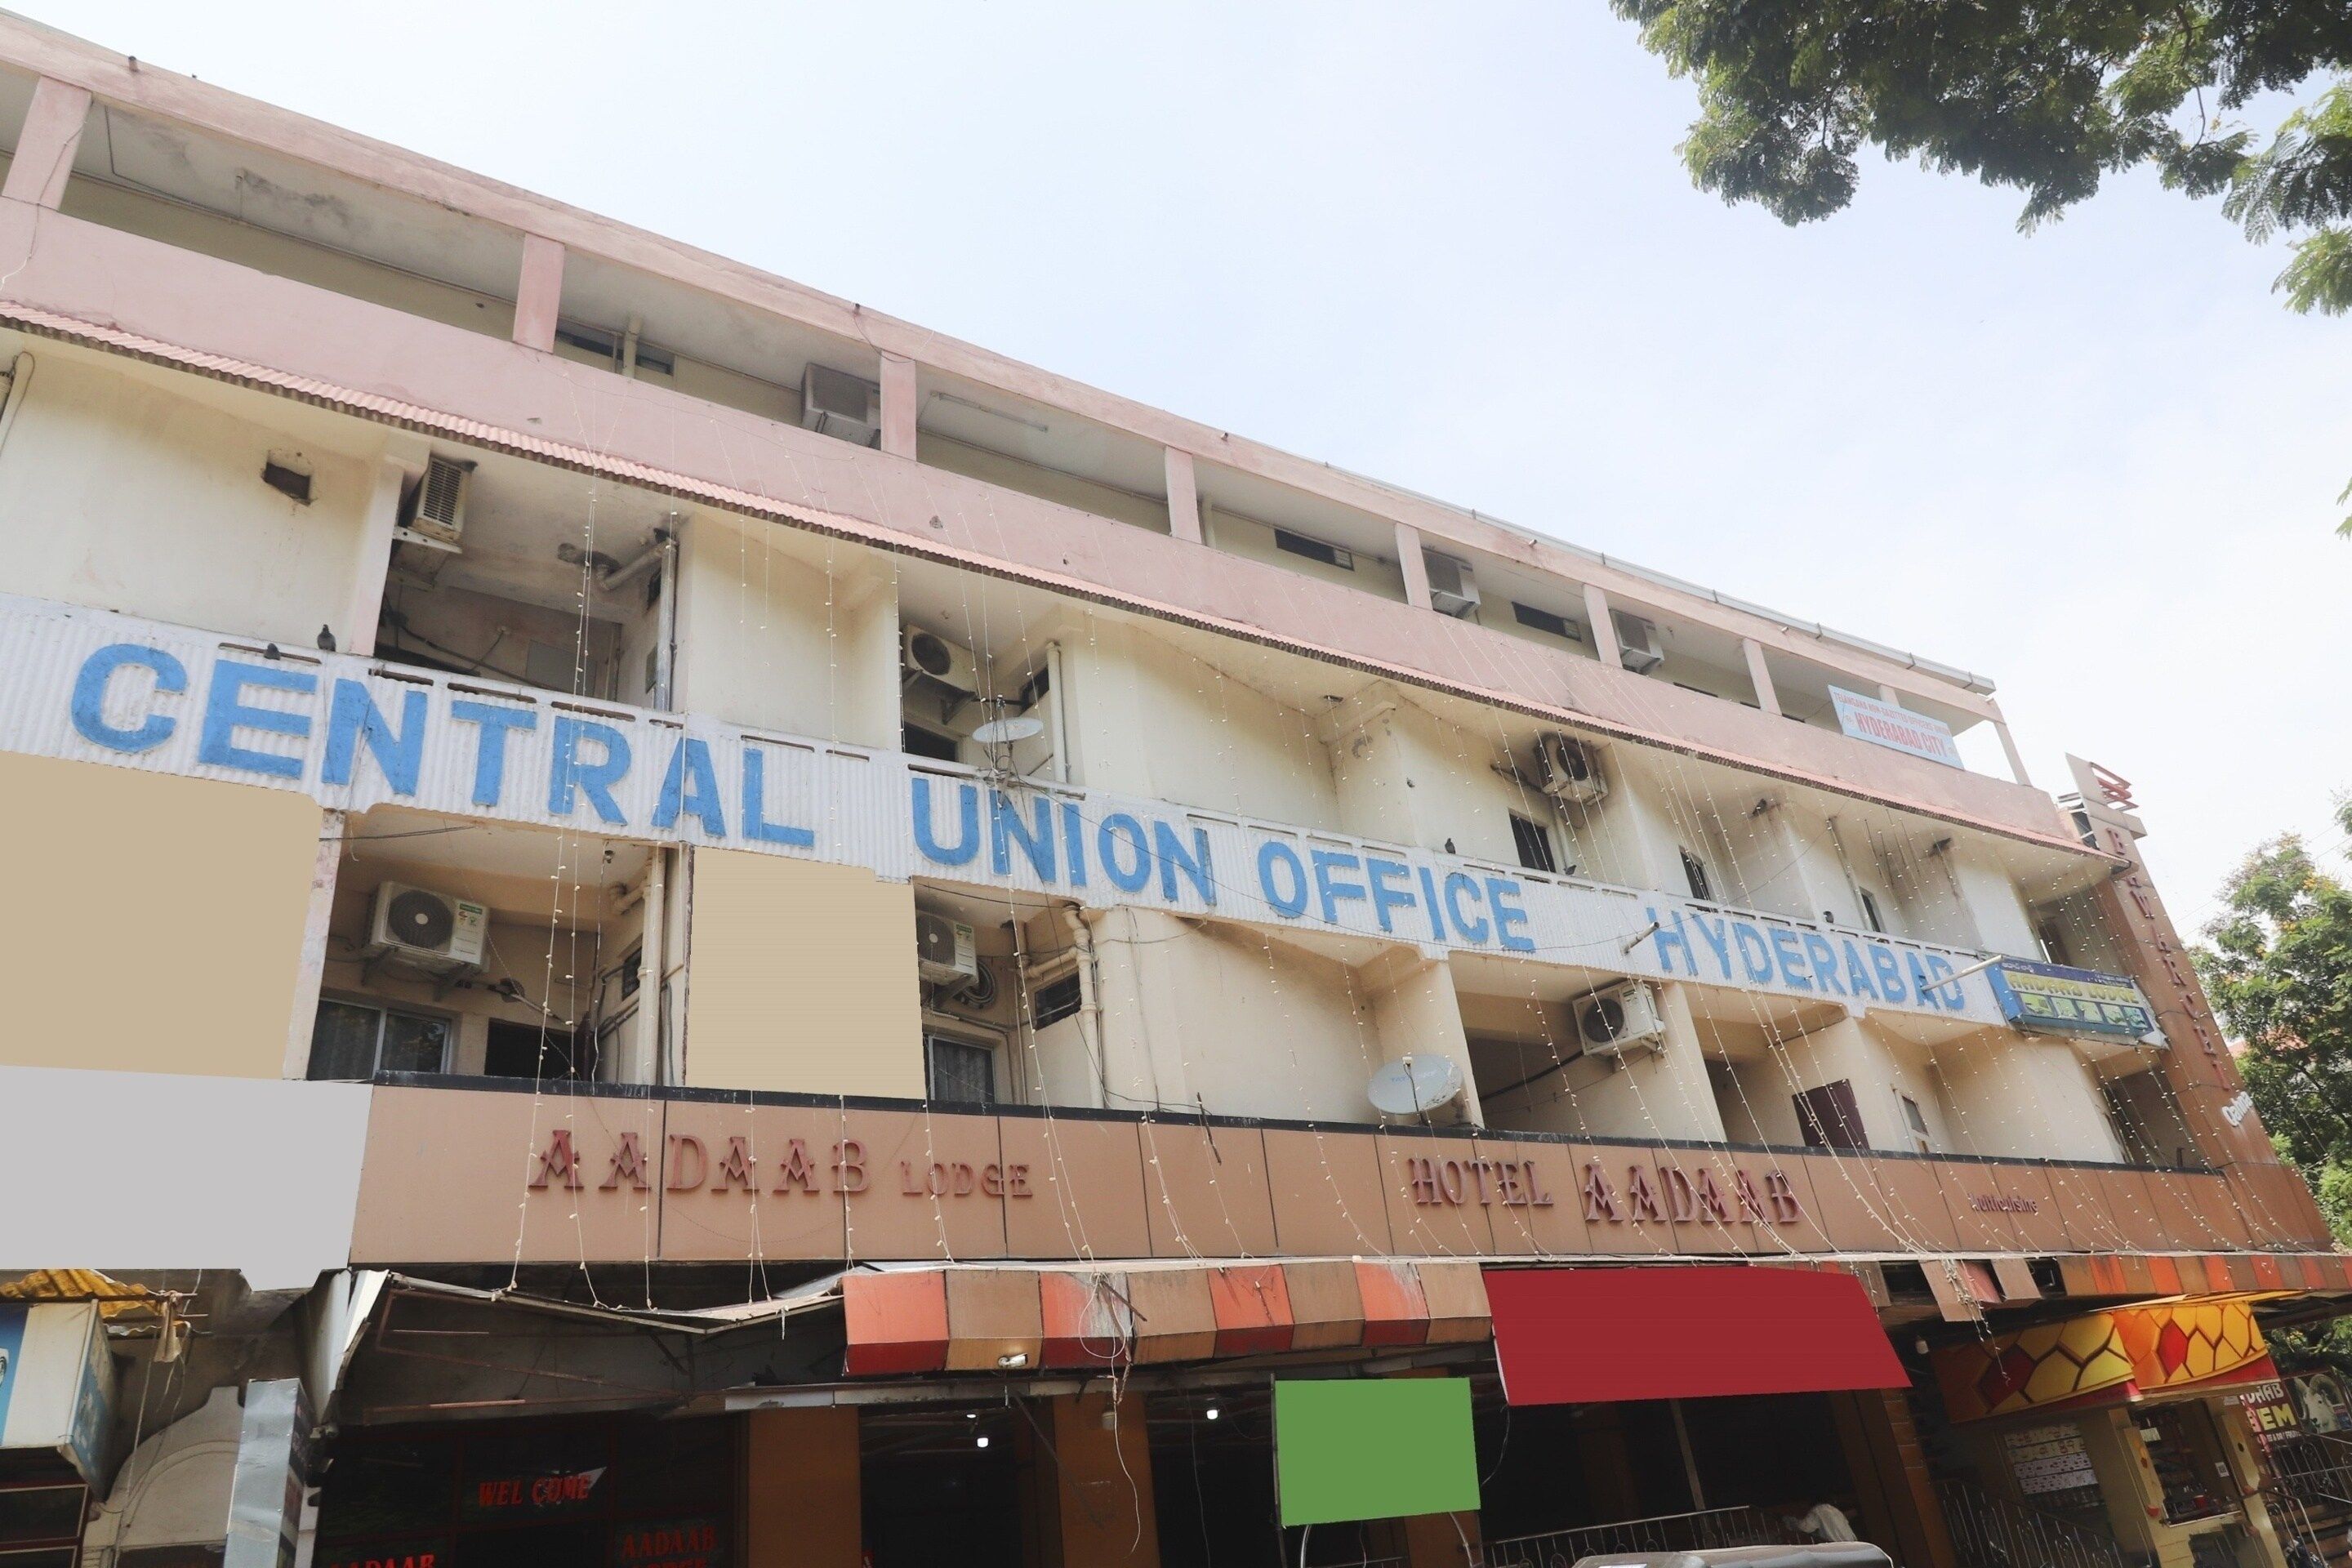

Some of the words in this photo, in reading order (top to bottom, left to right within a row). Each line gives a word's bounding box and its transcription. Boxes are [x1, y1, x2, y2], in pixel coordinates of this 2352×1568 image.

[1854, 711, 1922, 751] HYDERABAD
[1920, 731, 1949, 759] CITY
[72, 644, 814, 847] CENTRAL
[911, 777, 1217, 906] UNION
[1258, 841, 1535, 954] OFFICE
[1646, 906, 1966, 1011] HYDERABAD
[528, 1129, 871, 1194] AADAAB
[901, 1160, 1034, 1198] LODGE
[1408, 1157, 1555, 1205] HOTEL
[1584, 1163, 1801, 1224] AADAAB
[479, 1481, 523, 1507] WEL
[532, 1475, 591, 1504] COME
